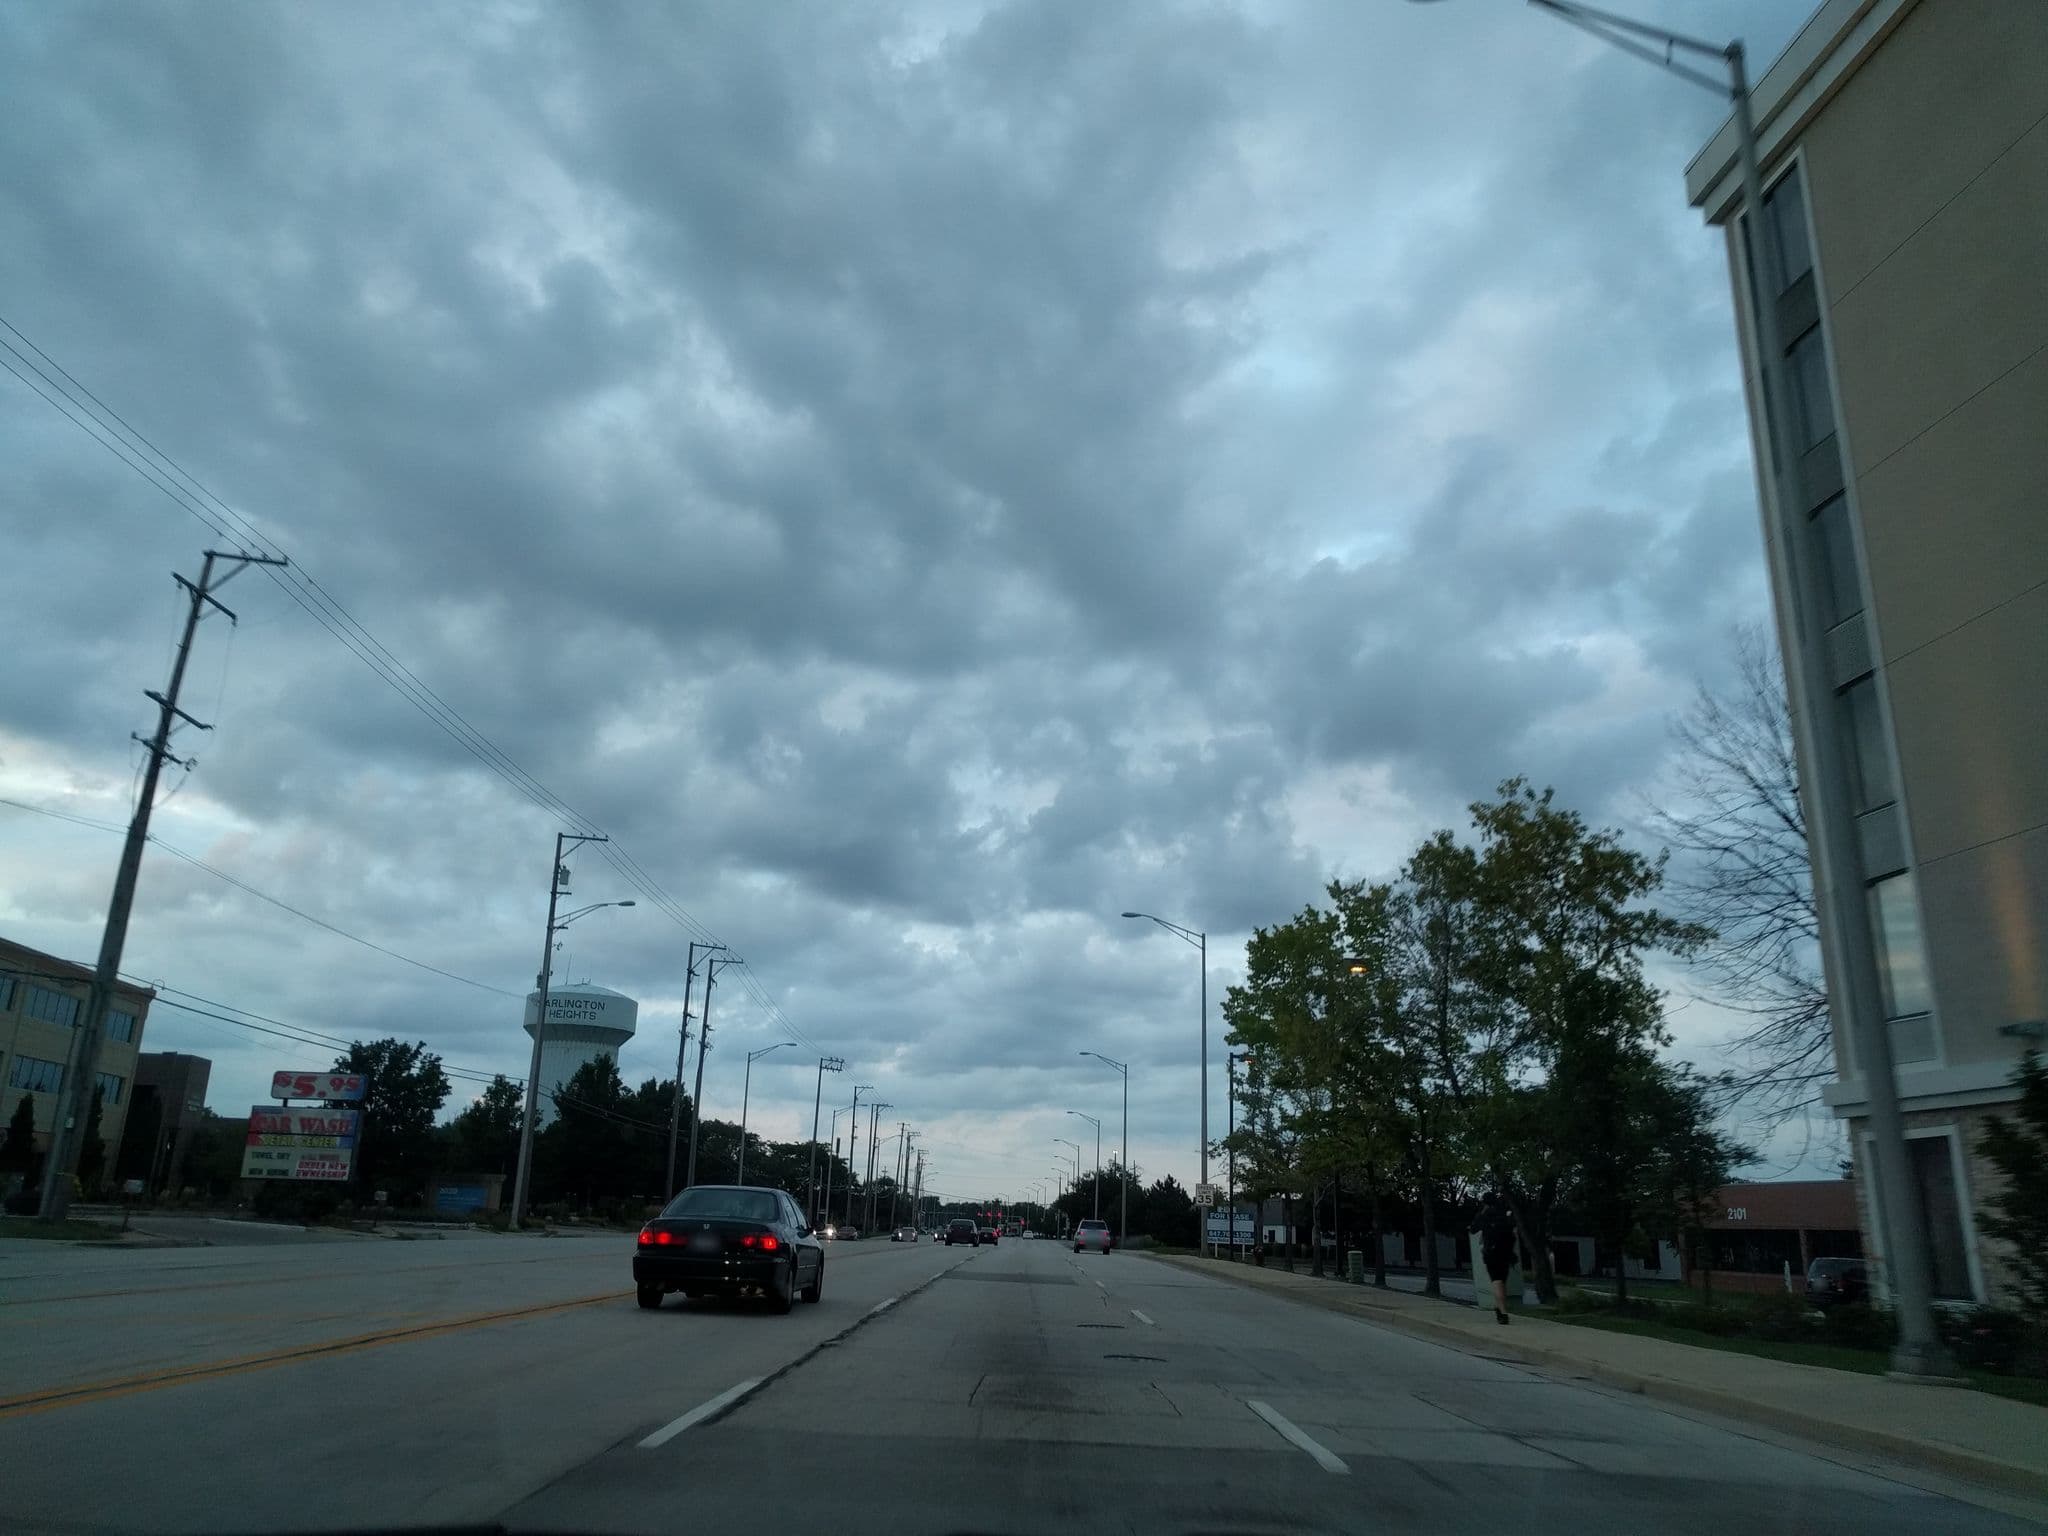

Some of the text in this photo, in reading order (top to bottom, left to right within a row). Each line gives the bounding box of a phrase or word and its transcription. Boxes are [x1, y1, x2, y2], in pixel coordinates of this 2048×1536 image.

[545, 999, 605, 1010] ARLINGTON
[549, 1010, 597, 1020] HEIGHTS
[254, 1114, 352, 1133] CAR WASH
[298, 1160, 348, 1170] UNDER NEW
[296, 1169, 347, 1178] OWNERSHIP
[1198, 1194, 1212, 1203] 35
[1727, 1208, 1747, 1220] 2101
